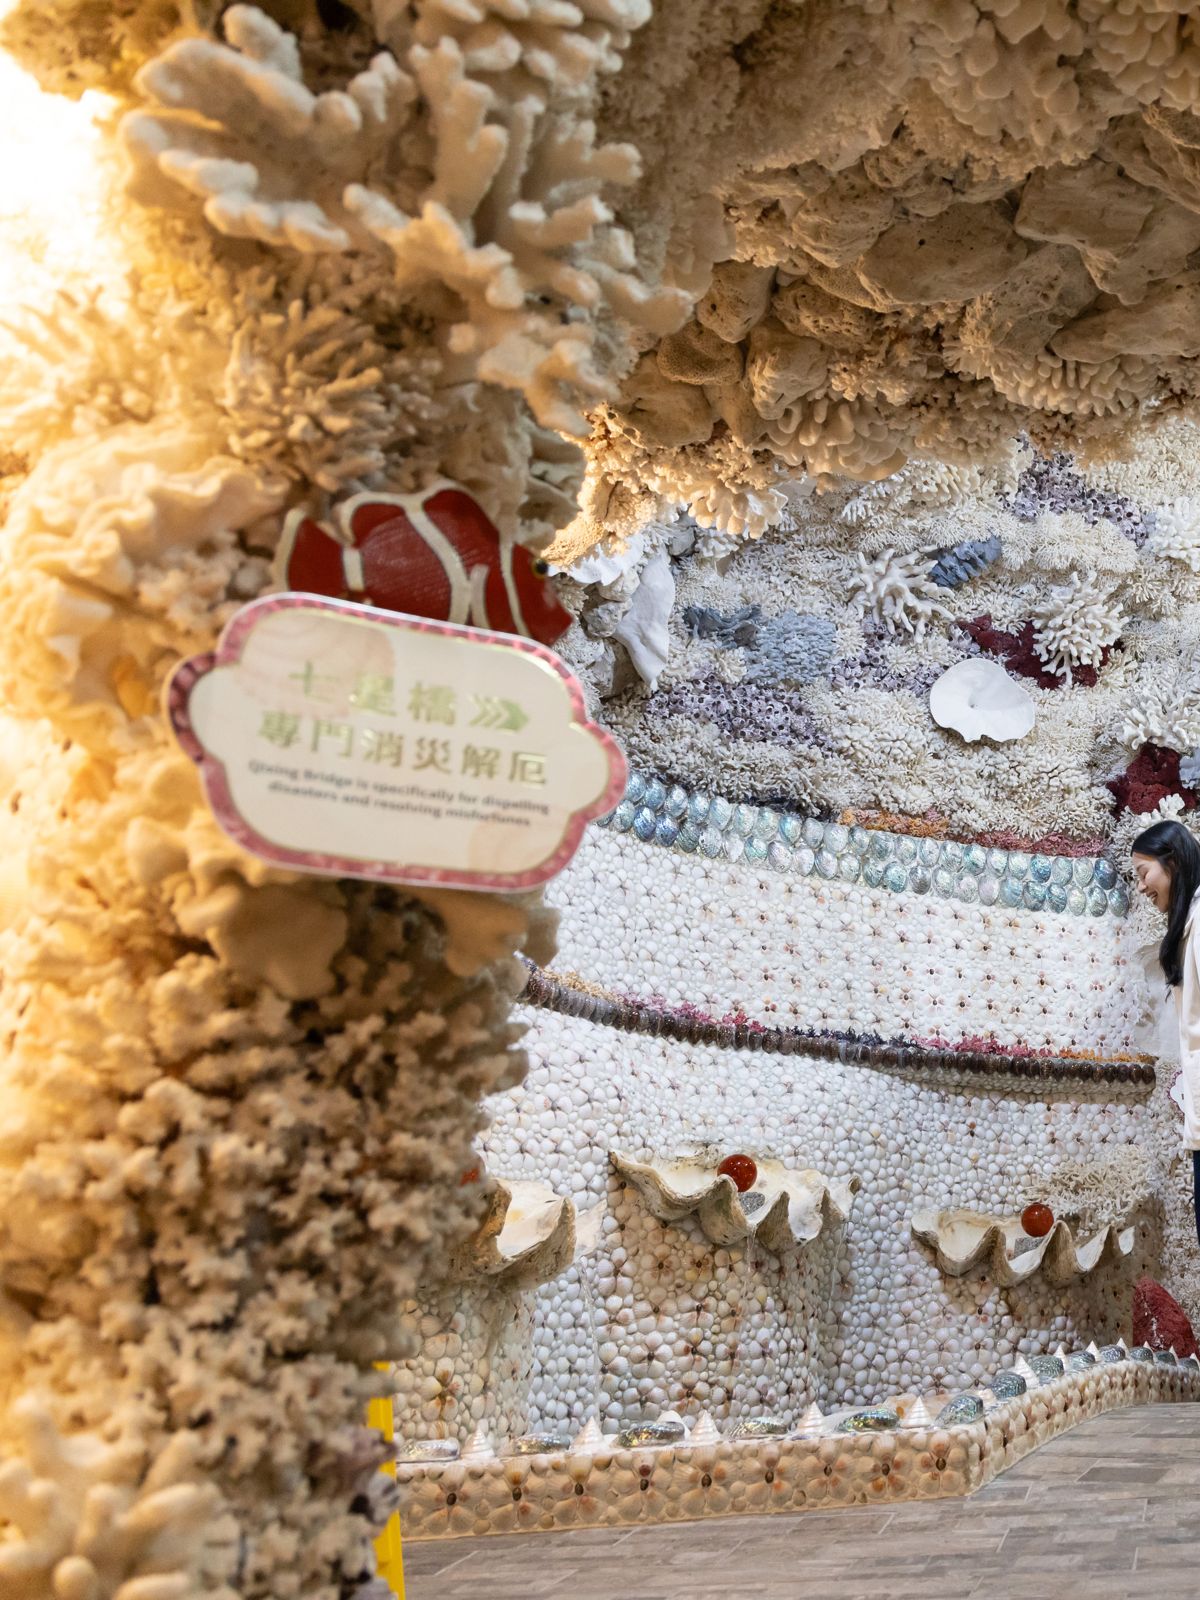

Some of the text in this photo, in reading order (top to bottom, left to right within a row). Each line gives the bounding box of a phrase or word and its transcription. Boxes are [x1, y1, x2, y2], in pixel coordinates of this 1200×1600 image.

[257, 708, 548, 787] 專門消災解厄
[248, 758, 549, 816] Qixing Bridge is specifically for dispelling
[267, 779, 530, 827] disasters and resolving misfortunes
